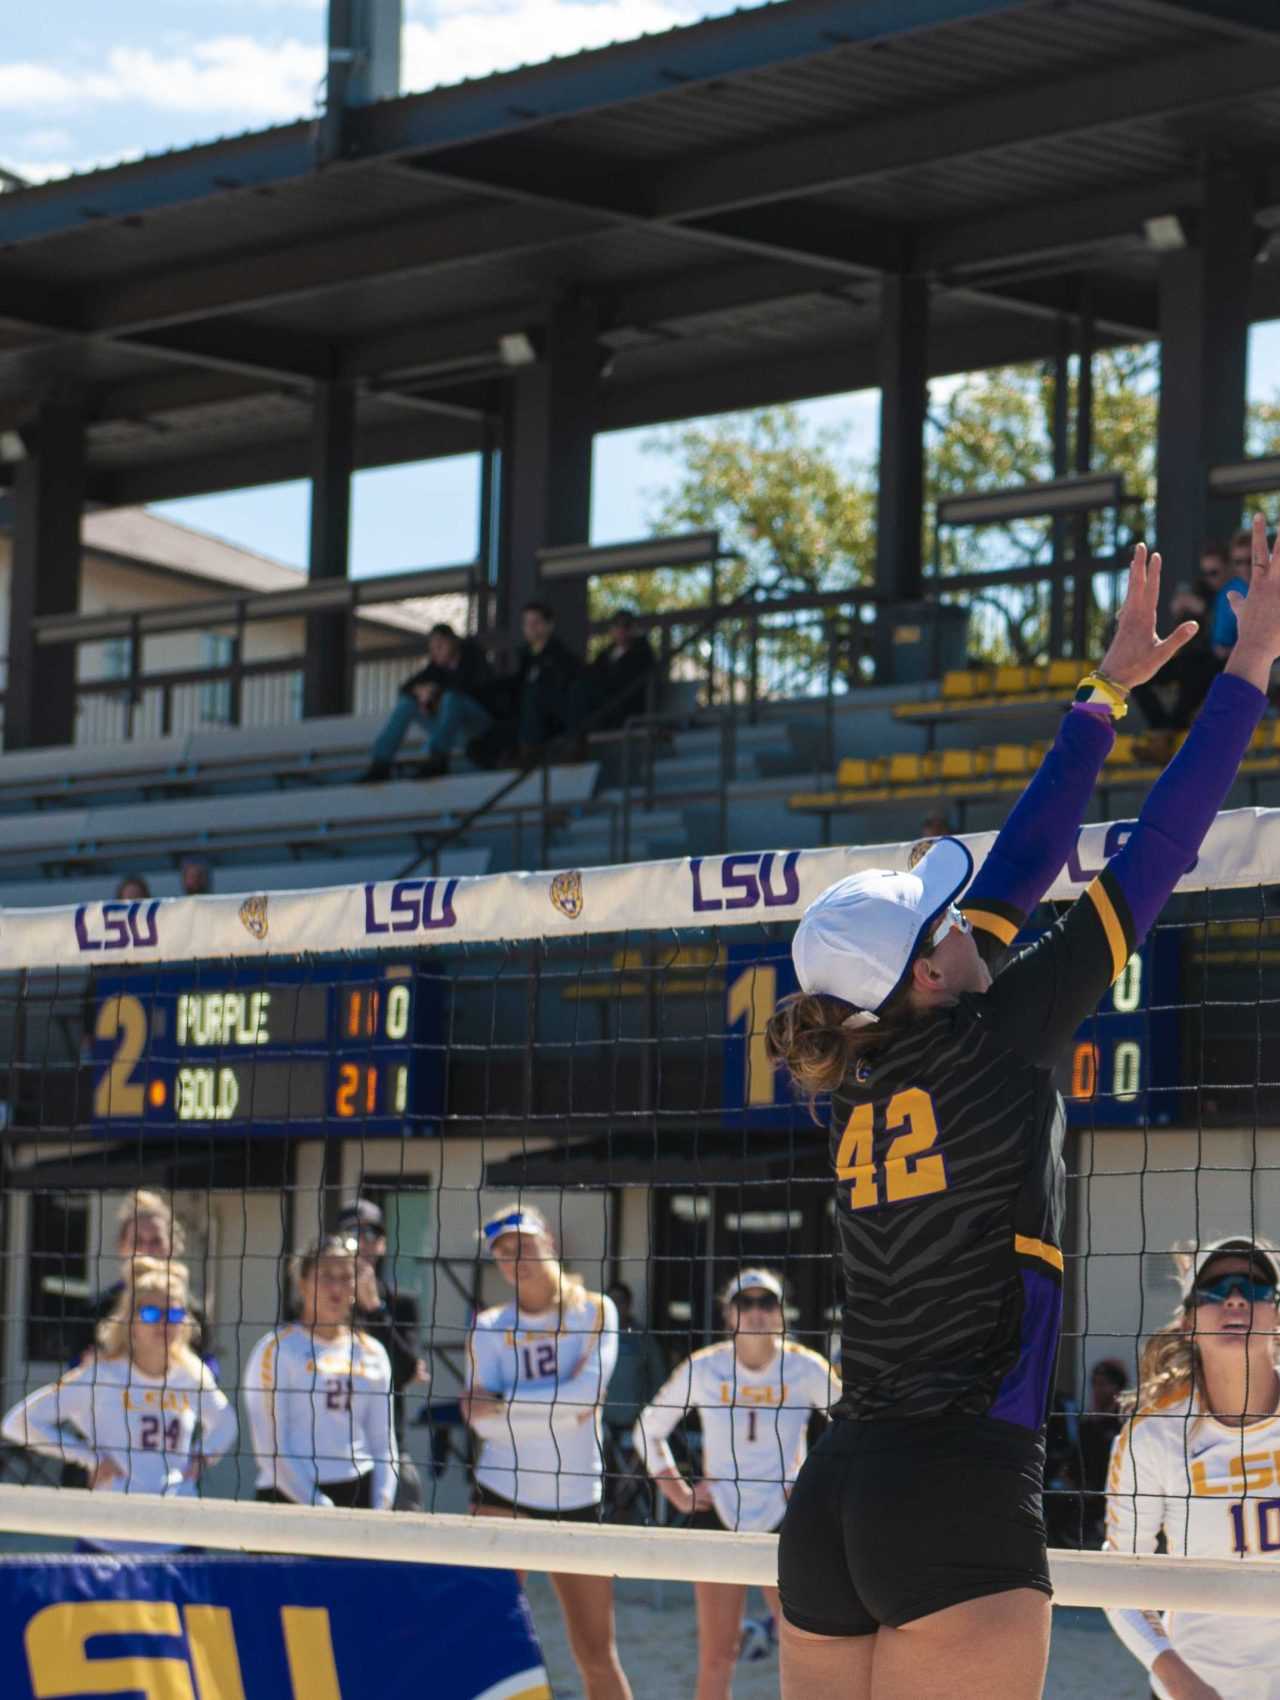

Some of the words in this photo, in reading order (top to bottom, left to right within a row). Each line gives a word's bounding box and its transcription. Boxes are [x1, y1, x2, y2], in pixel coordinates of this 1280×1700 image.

[364, 879, 458, 934] LSU
[690, 852, 800, 912] LSU
[74, 902, 160, 951] LSU
[176, 992, 271, 1046] PURPLE
[385, 984, 410, 1039] 0
[727, 966, 776, 1105] 1
[95, 994, 148, 1118] 2
[1113, 1042, 1141, 1101] 0
[335, 1063, 377, 1117] 21
[395, 1065, 408, 1112] 1
[833, 1084, 949, 1212] 42
[523, 1344, 557, 1380] 12
[720, 1382, 789, 1405] LSU
[141, 1416, 179, 1451] 24
[748, 1410, 757, 1442] 1
